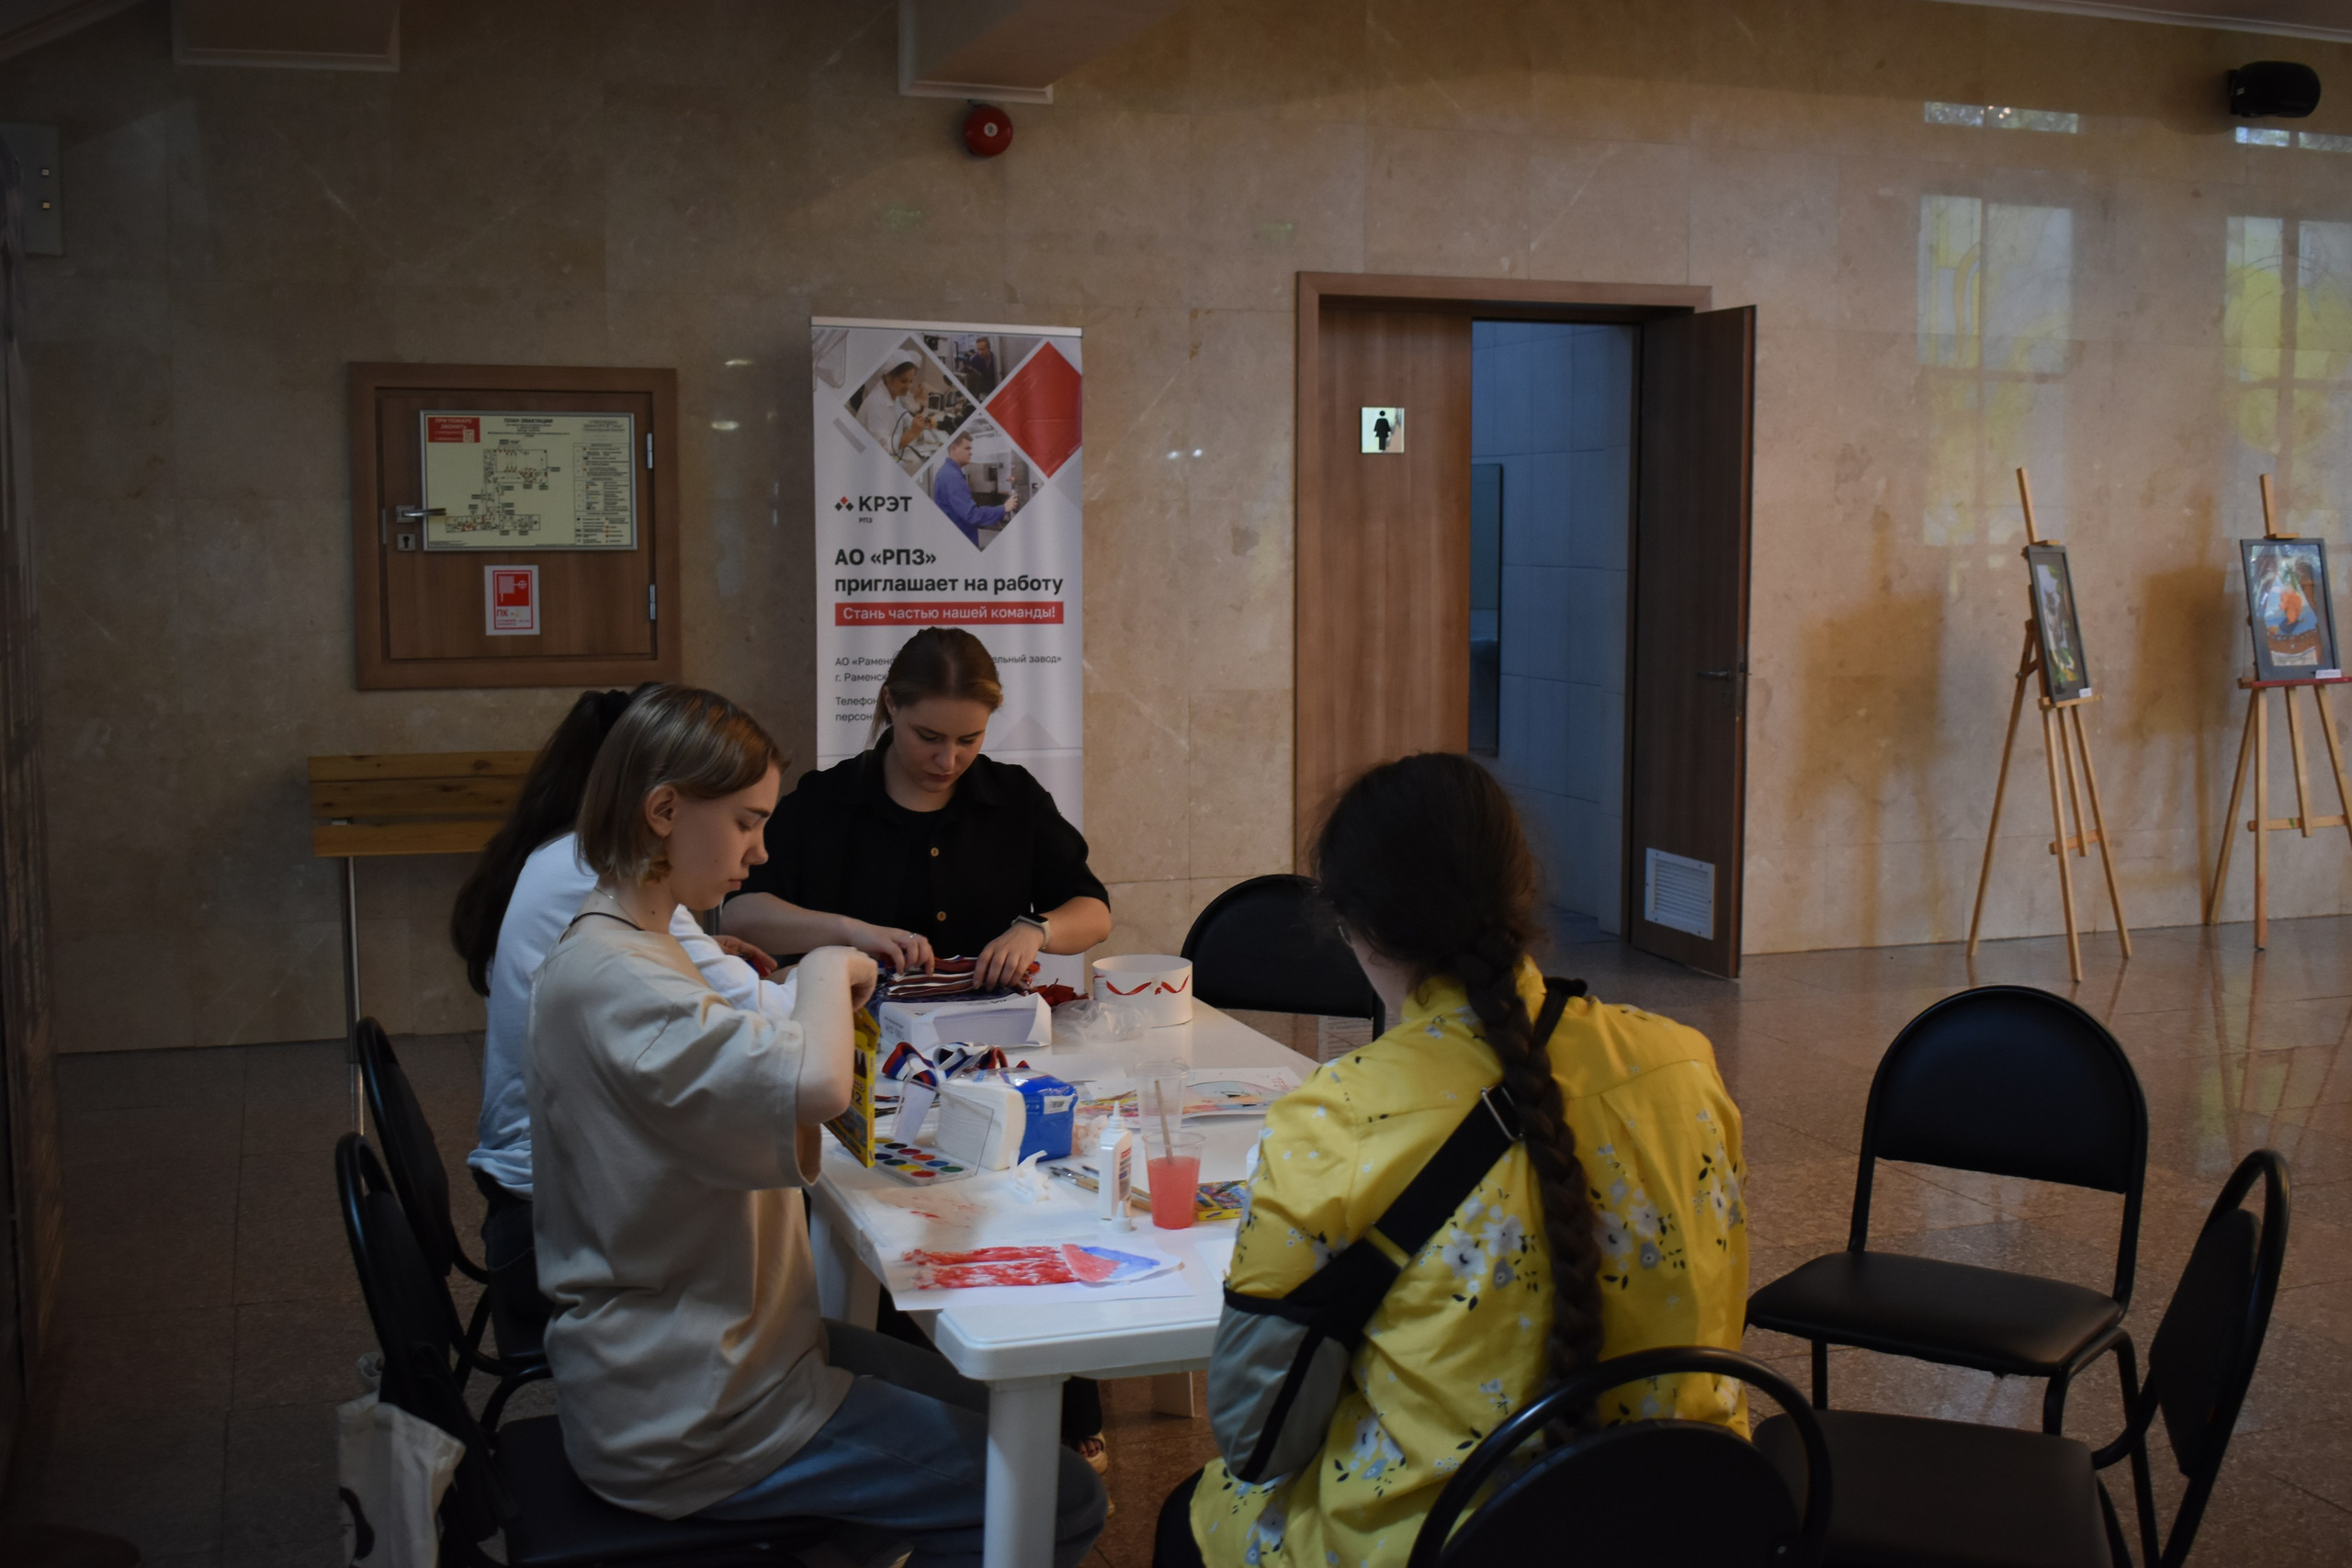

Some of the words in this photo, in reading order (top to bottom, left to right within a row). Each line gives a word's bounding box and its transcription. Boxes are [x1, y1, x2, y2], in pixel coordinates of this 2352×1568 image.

[859, 496, 912, 512] КРЭТ
[835, 548, 865, 565] АО
[871, 548, 936, 566] «РПЗ»
[835, 578, 958, 596] приглашает
[965, 578, 988, 592] на
[994, 574, 1063, 595] работу
[843, 607, 886, 620] Стань
[888, 608, 939, 619] частью
[943, 605, 988, 619] нашей
[990, 605, 1056, 620] команды!
[835, 657, 849, 666] АО
[1029, 654, 1062, 663] завод»
